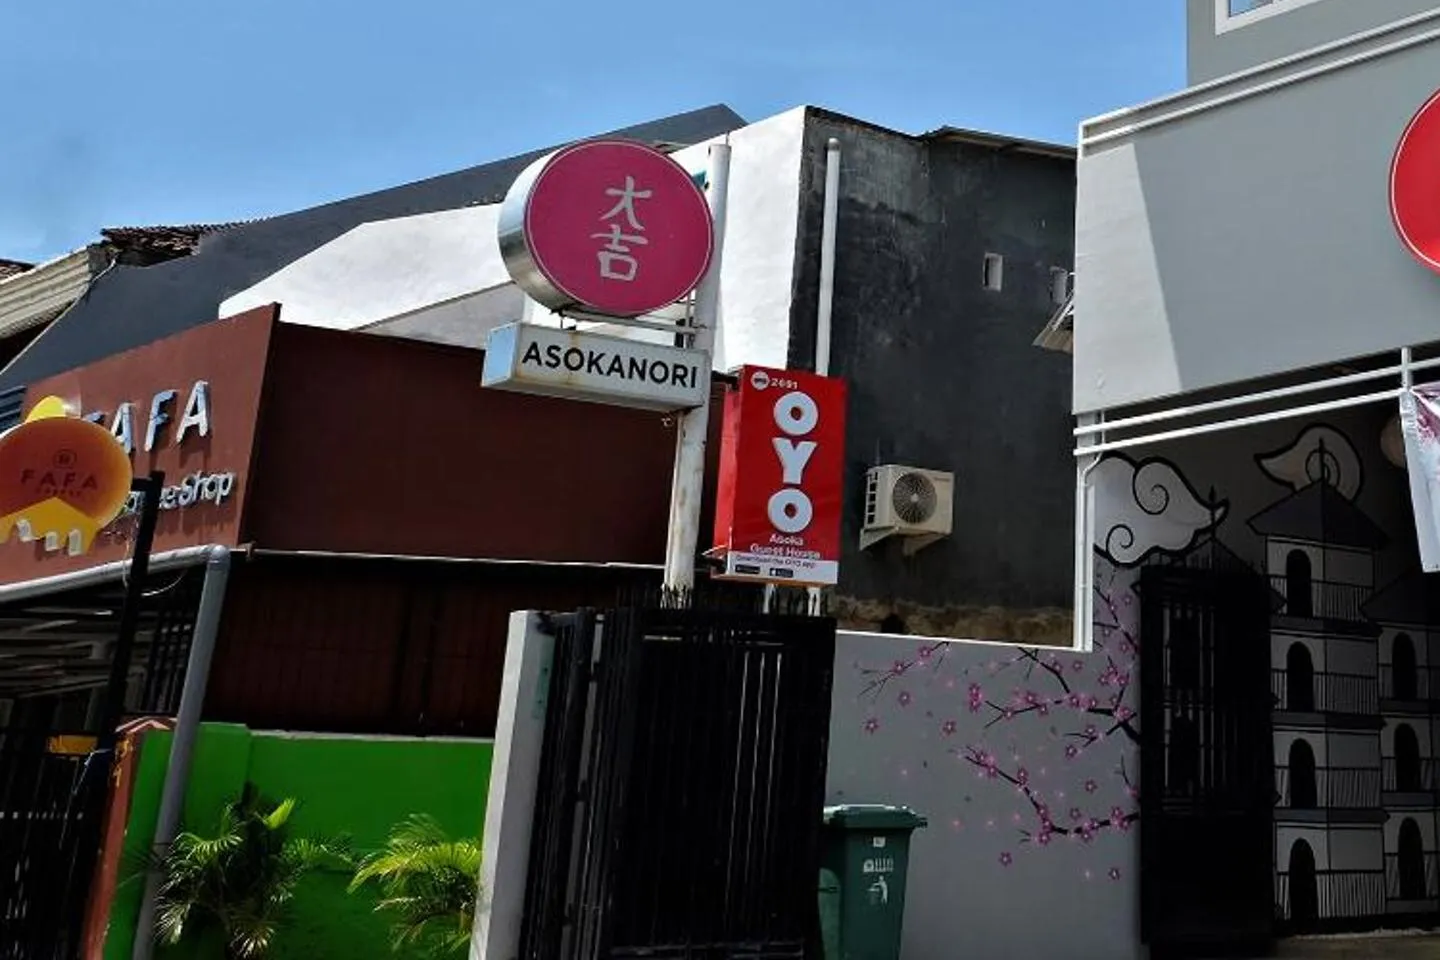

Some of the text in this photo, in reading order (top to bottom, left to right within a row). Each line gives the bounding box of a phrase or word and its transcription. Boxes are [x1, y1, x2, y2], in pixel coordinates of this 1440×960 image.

[590, 176, 653, 282] 大吉
[521, 341, 698, 389] ASOKANORI
[20, 468, 98, 491] FAFA
[767, 391, 819, 534] OYO
